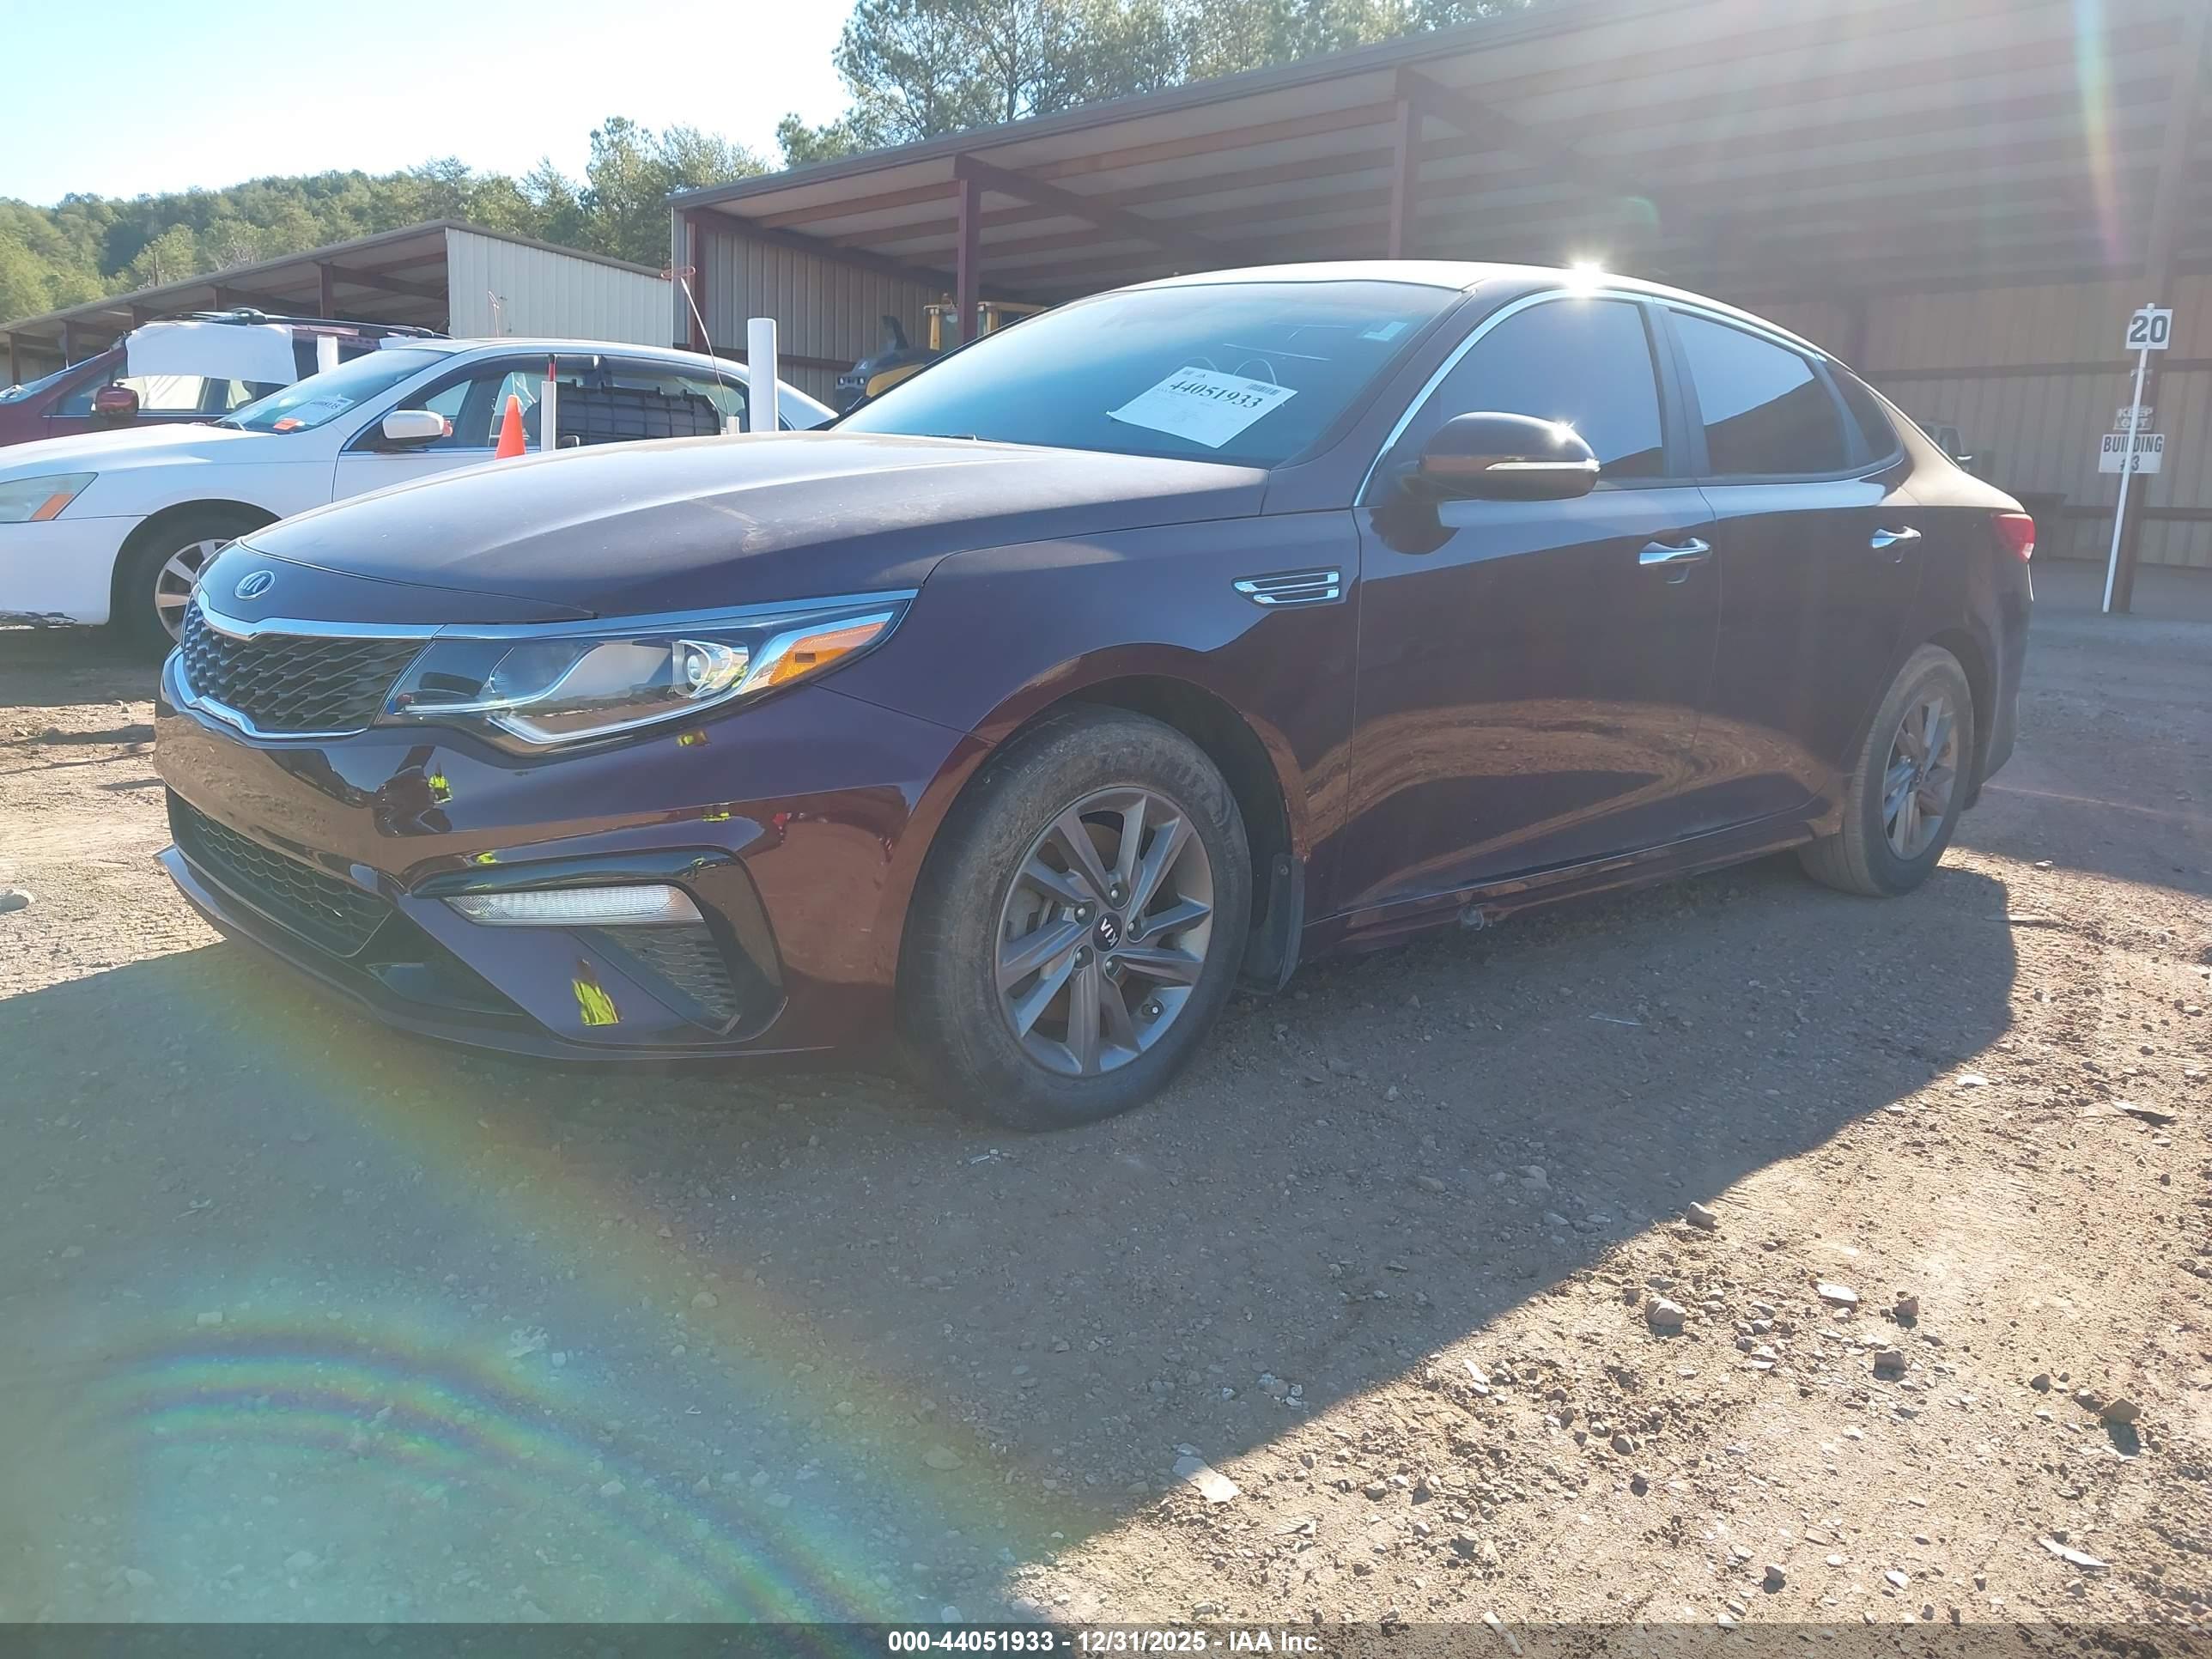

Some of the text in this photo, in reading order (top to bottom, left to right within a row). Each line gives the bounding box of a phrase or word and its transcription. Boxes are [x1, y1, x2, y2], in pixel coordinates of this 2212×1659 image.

[2130, 315, 2167, 343] 20
[1169, 380, 1263, 408] 44051933
[2121, 417, 2148, 428] OT
[1100, 917, 1119, 947] KIA
